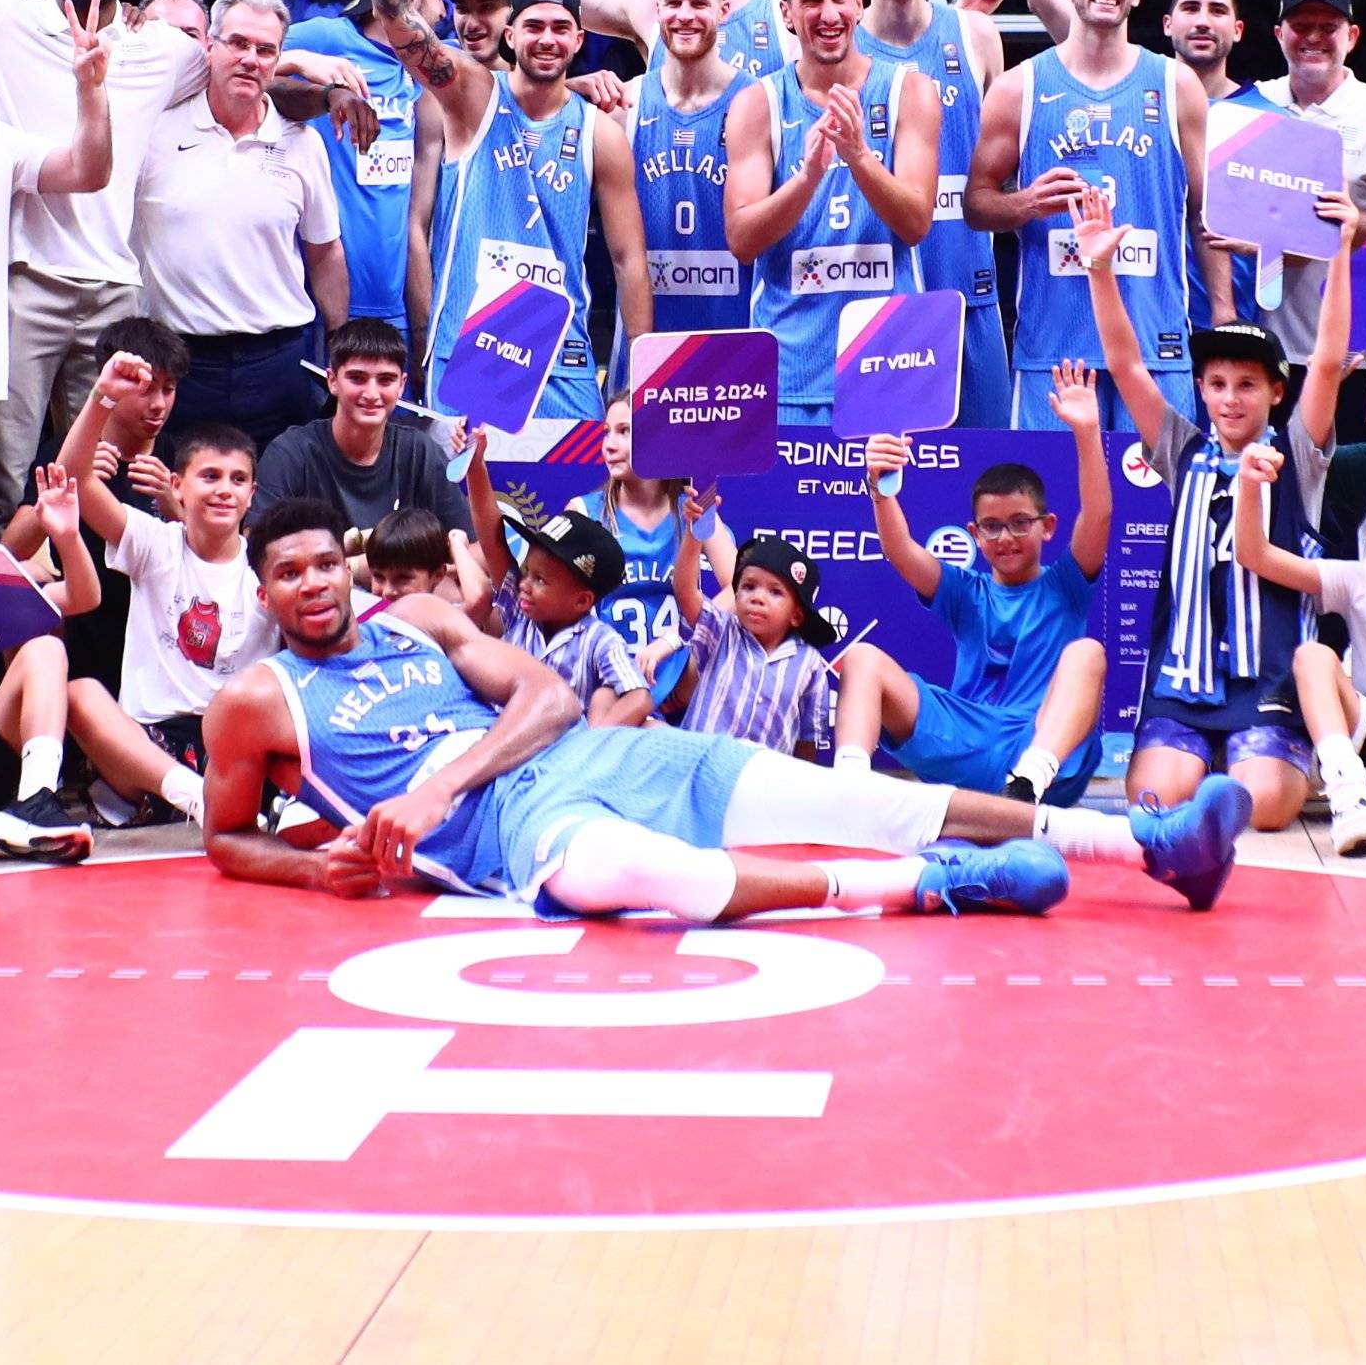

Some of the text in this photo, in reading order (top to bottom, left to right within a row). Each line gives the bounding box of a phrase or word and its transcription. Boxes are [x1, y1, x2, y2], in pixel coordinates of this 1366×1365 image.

[1049, 121, 1154, 161] HELLAS
[643, 148, 729, 186] HELLAS
[1227, 161, 1324, 195] EN ROUTE
[525, 195, 542, 230] 7
[675, 200, 696, 236] 0
[828, 194, 852, 231] 5
[475, 333, 532, 368] ET VOILÀ
[859, 348, 936, 375] ET VOILÀ
[644, 383, 767, 405] PARIS 2024
[669, 406, 741, 424] BOUND
[797, 479, 869, 496] ET VOILÀ
[612, 597, 681, 655] 34
[329, 660, 443, 731] HELLAS
